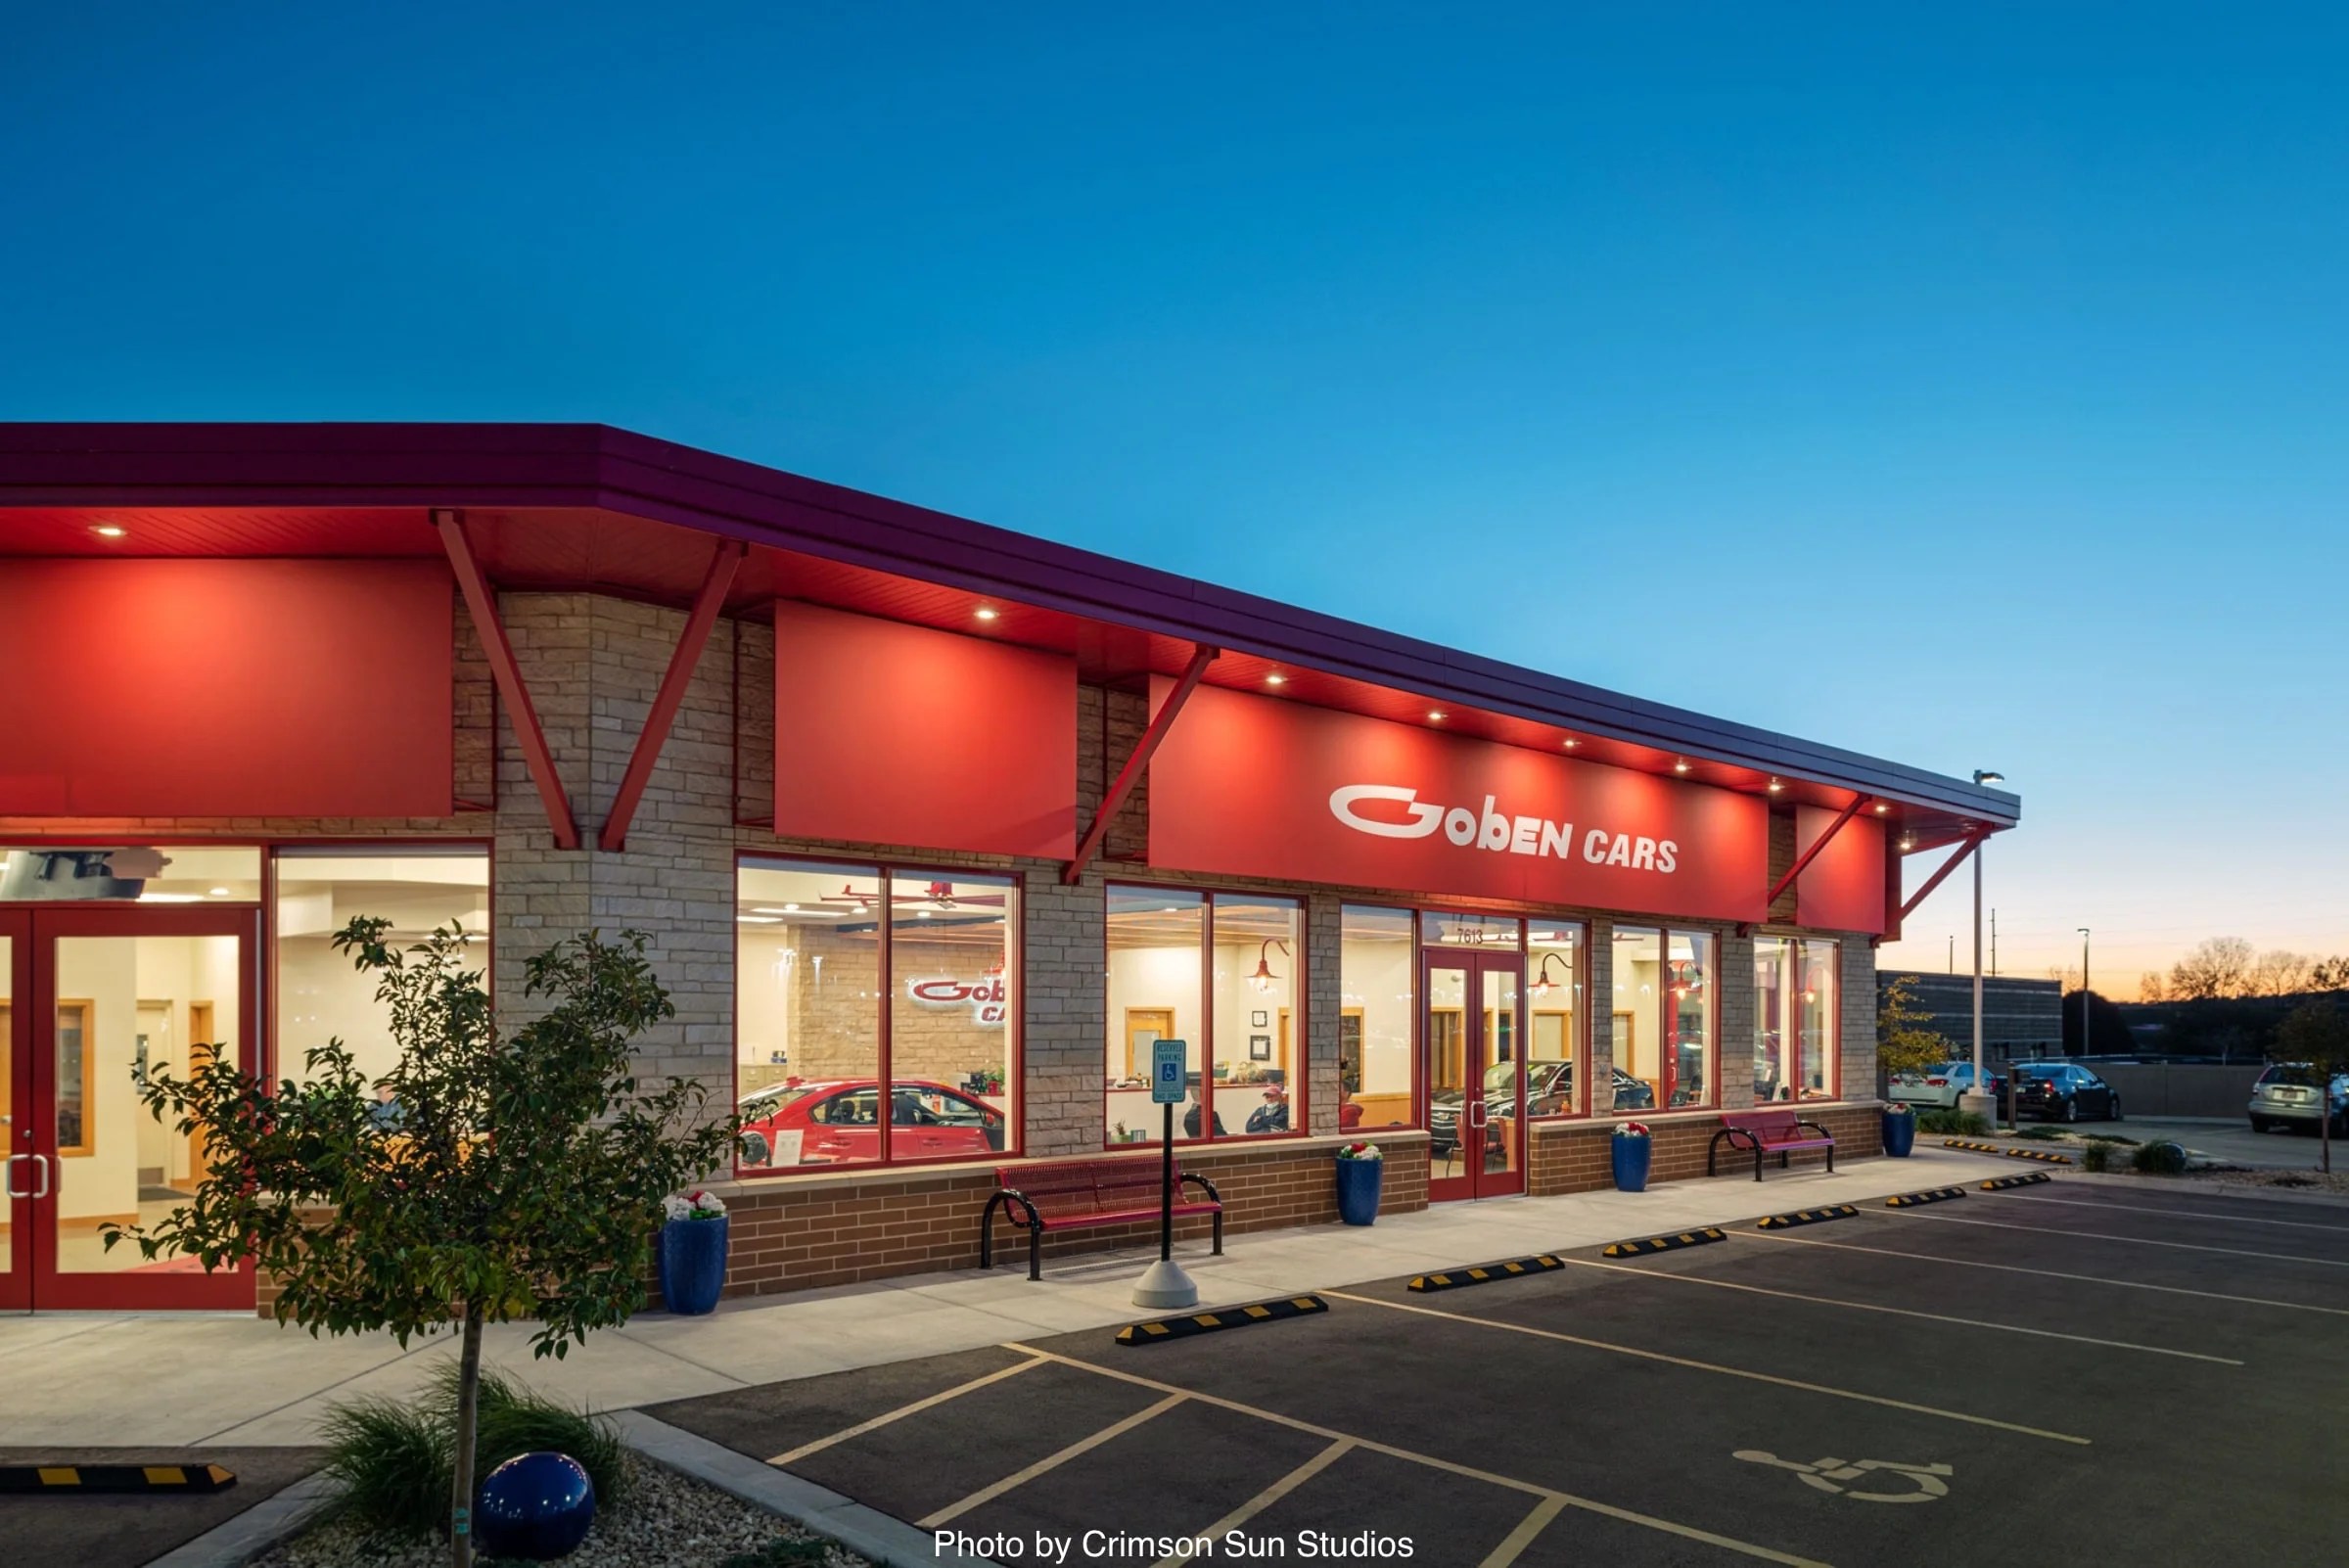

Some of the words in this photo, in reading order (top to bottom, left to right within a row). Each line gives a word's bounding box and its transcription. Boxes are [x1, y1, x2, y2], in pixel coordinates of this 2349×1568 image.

[1583, 829, 1679, 873] CARS
[1457, 928, 1483, 945] 7613
[1158, 1053, 1182, 1062] PARKING
